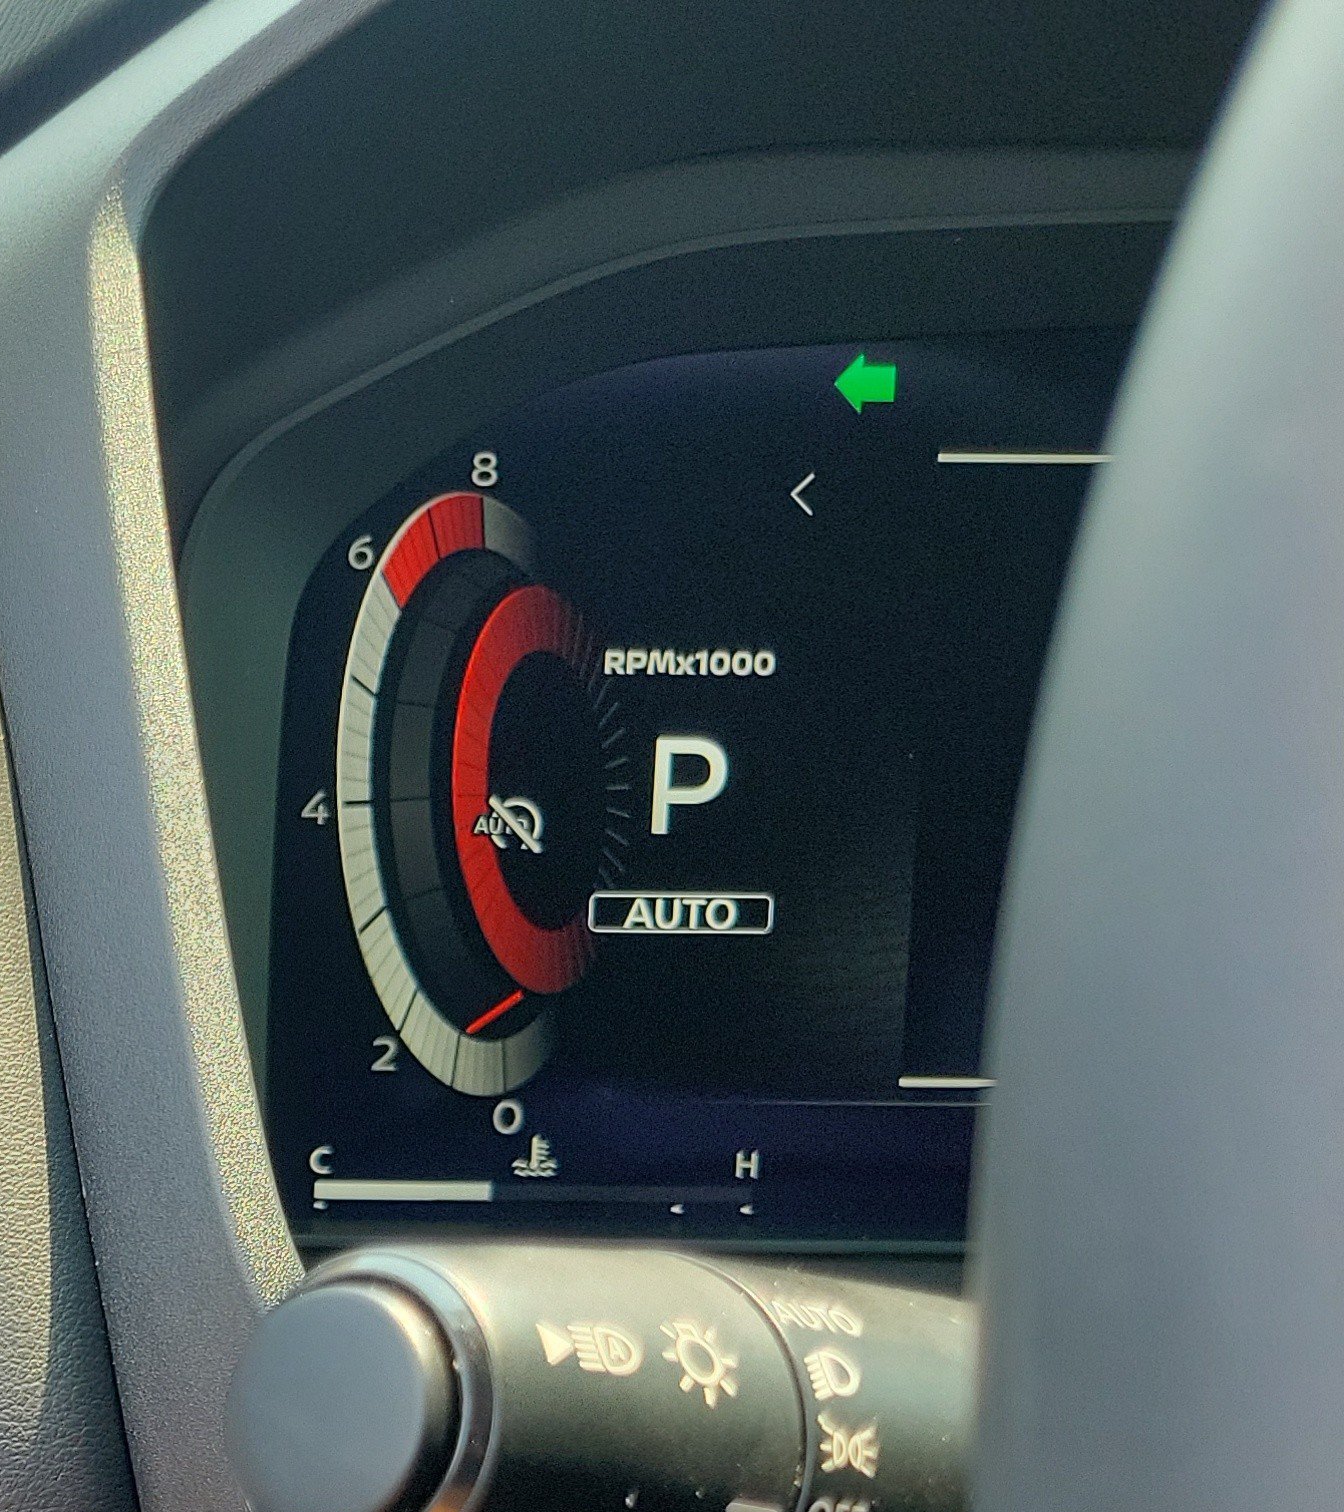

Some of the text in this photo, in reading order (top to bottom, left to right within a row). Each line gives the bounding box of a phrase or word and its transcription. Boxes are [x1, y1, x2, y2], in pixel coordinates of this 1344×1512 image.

[470, 451, 499, 488] 8
[347, 535, 375, 571] 6
[603, 648, 777, 677] RPMx1000
[650, 735, 729, 836] P
[300, 790, 330, 826] 4
[621, 896, 739, 931] AUTO
[370, 1039, 398, 1072] 2
[492, 1099, 524, 1136] 0
[309, 1145, 334, 1175] C
[734, 1149, 760, 1179] H
[771, 1300, 863, 1338] AUTO
